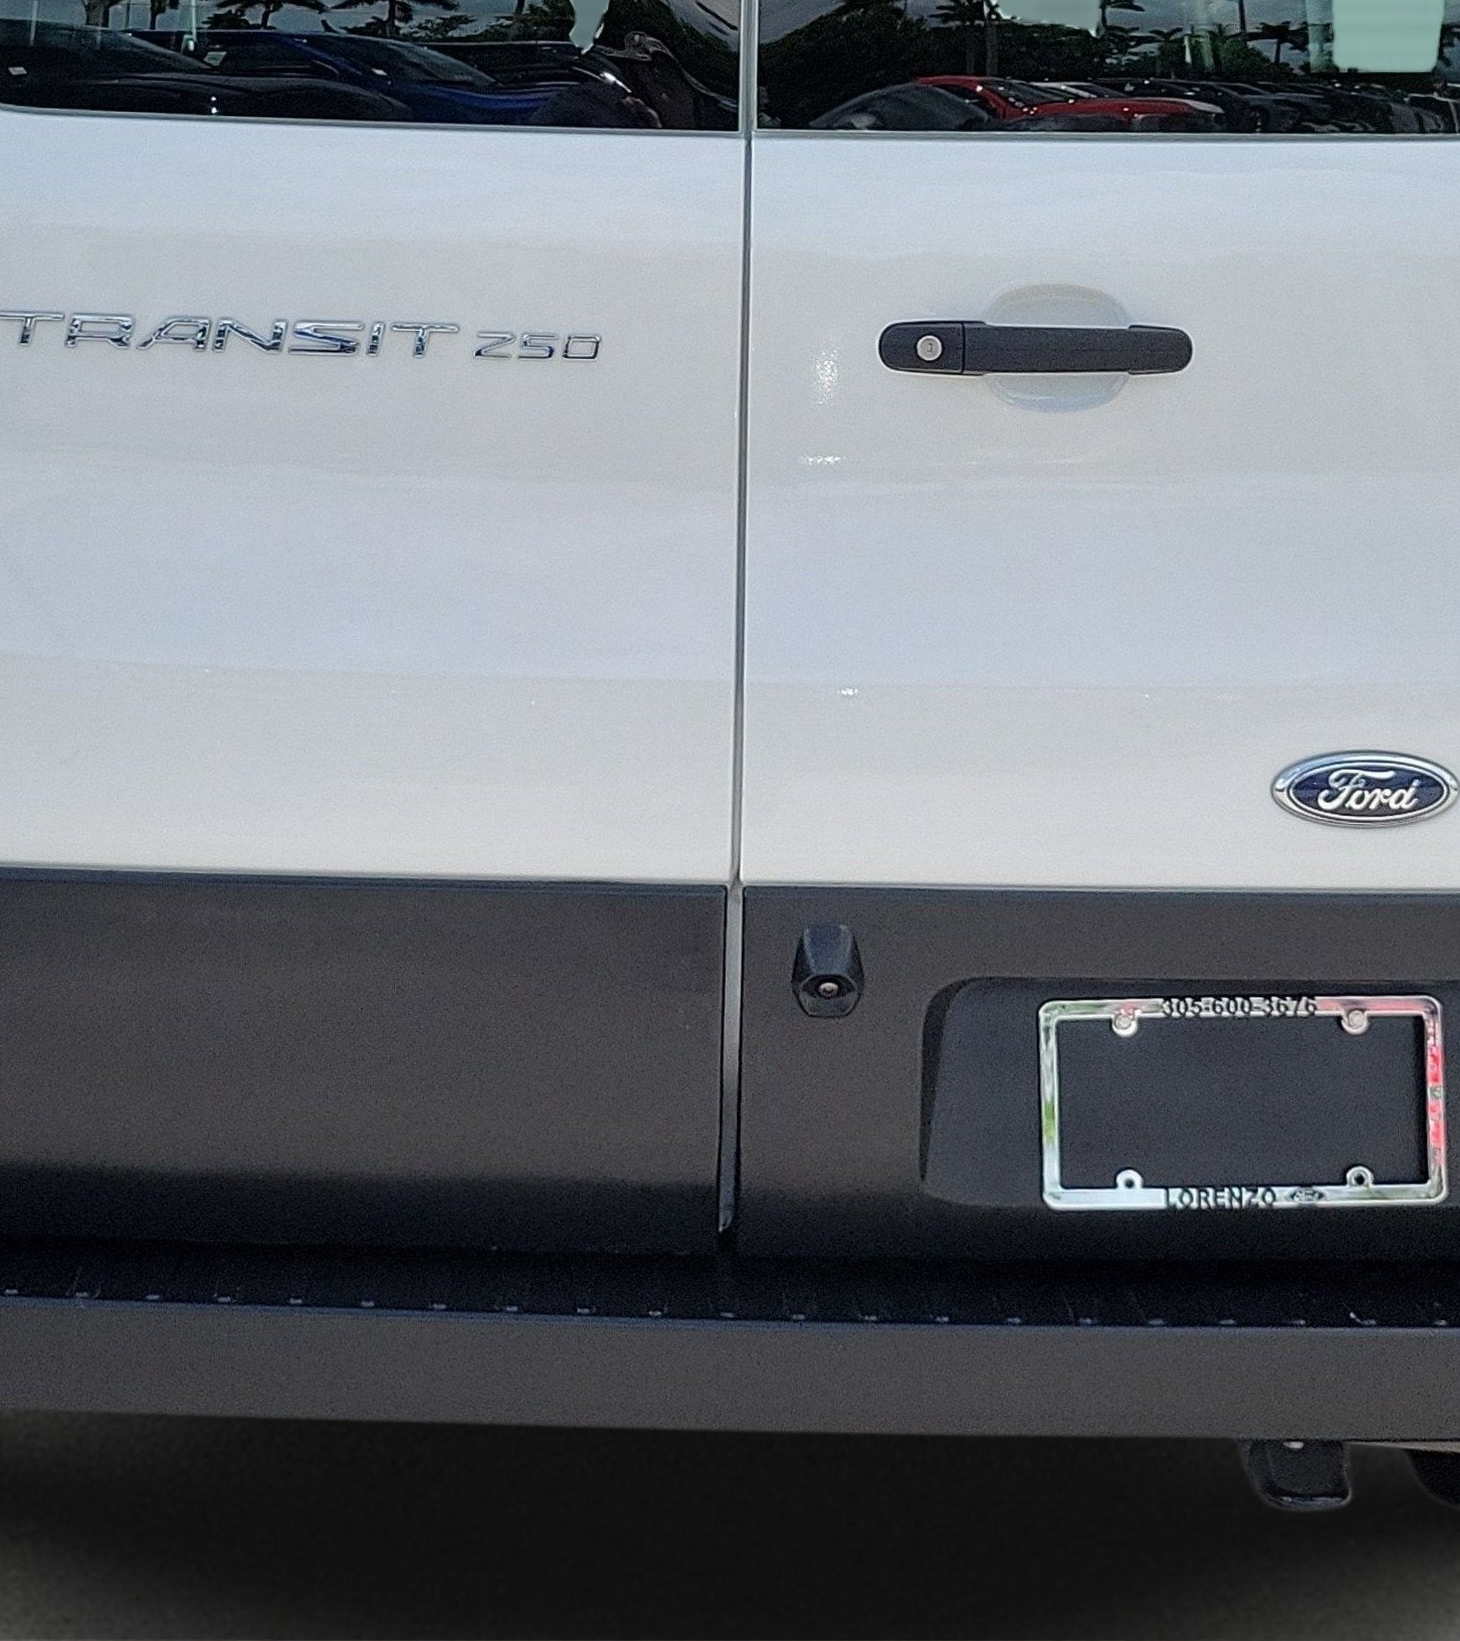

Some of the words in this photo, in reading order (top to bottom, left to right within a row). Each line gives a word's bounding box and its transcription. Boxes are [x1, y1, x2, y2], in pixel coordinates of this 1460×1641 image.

[472, 330, 603, 361] 250
[1316, 768, 1421, 811] Ford
[1163, 1186, 1277, 1209] LORENZO
